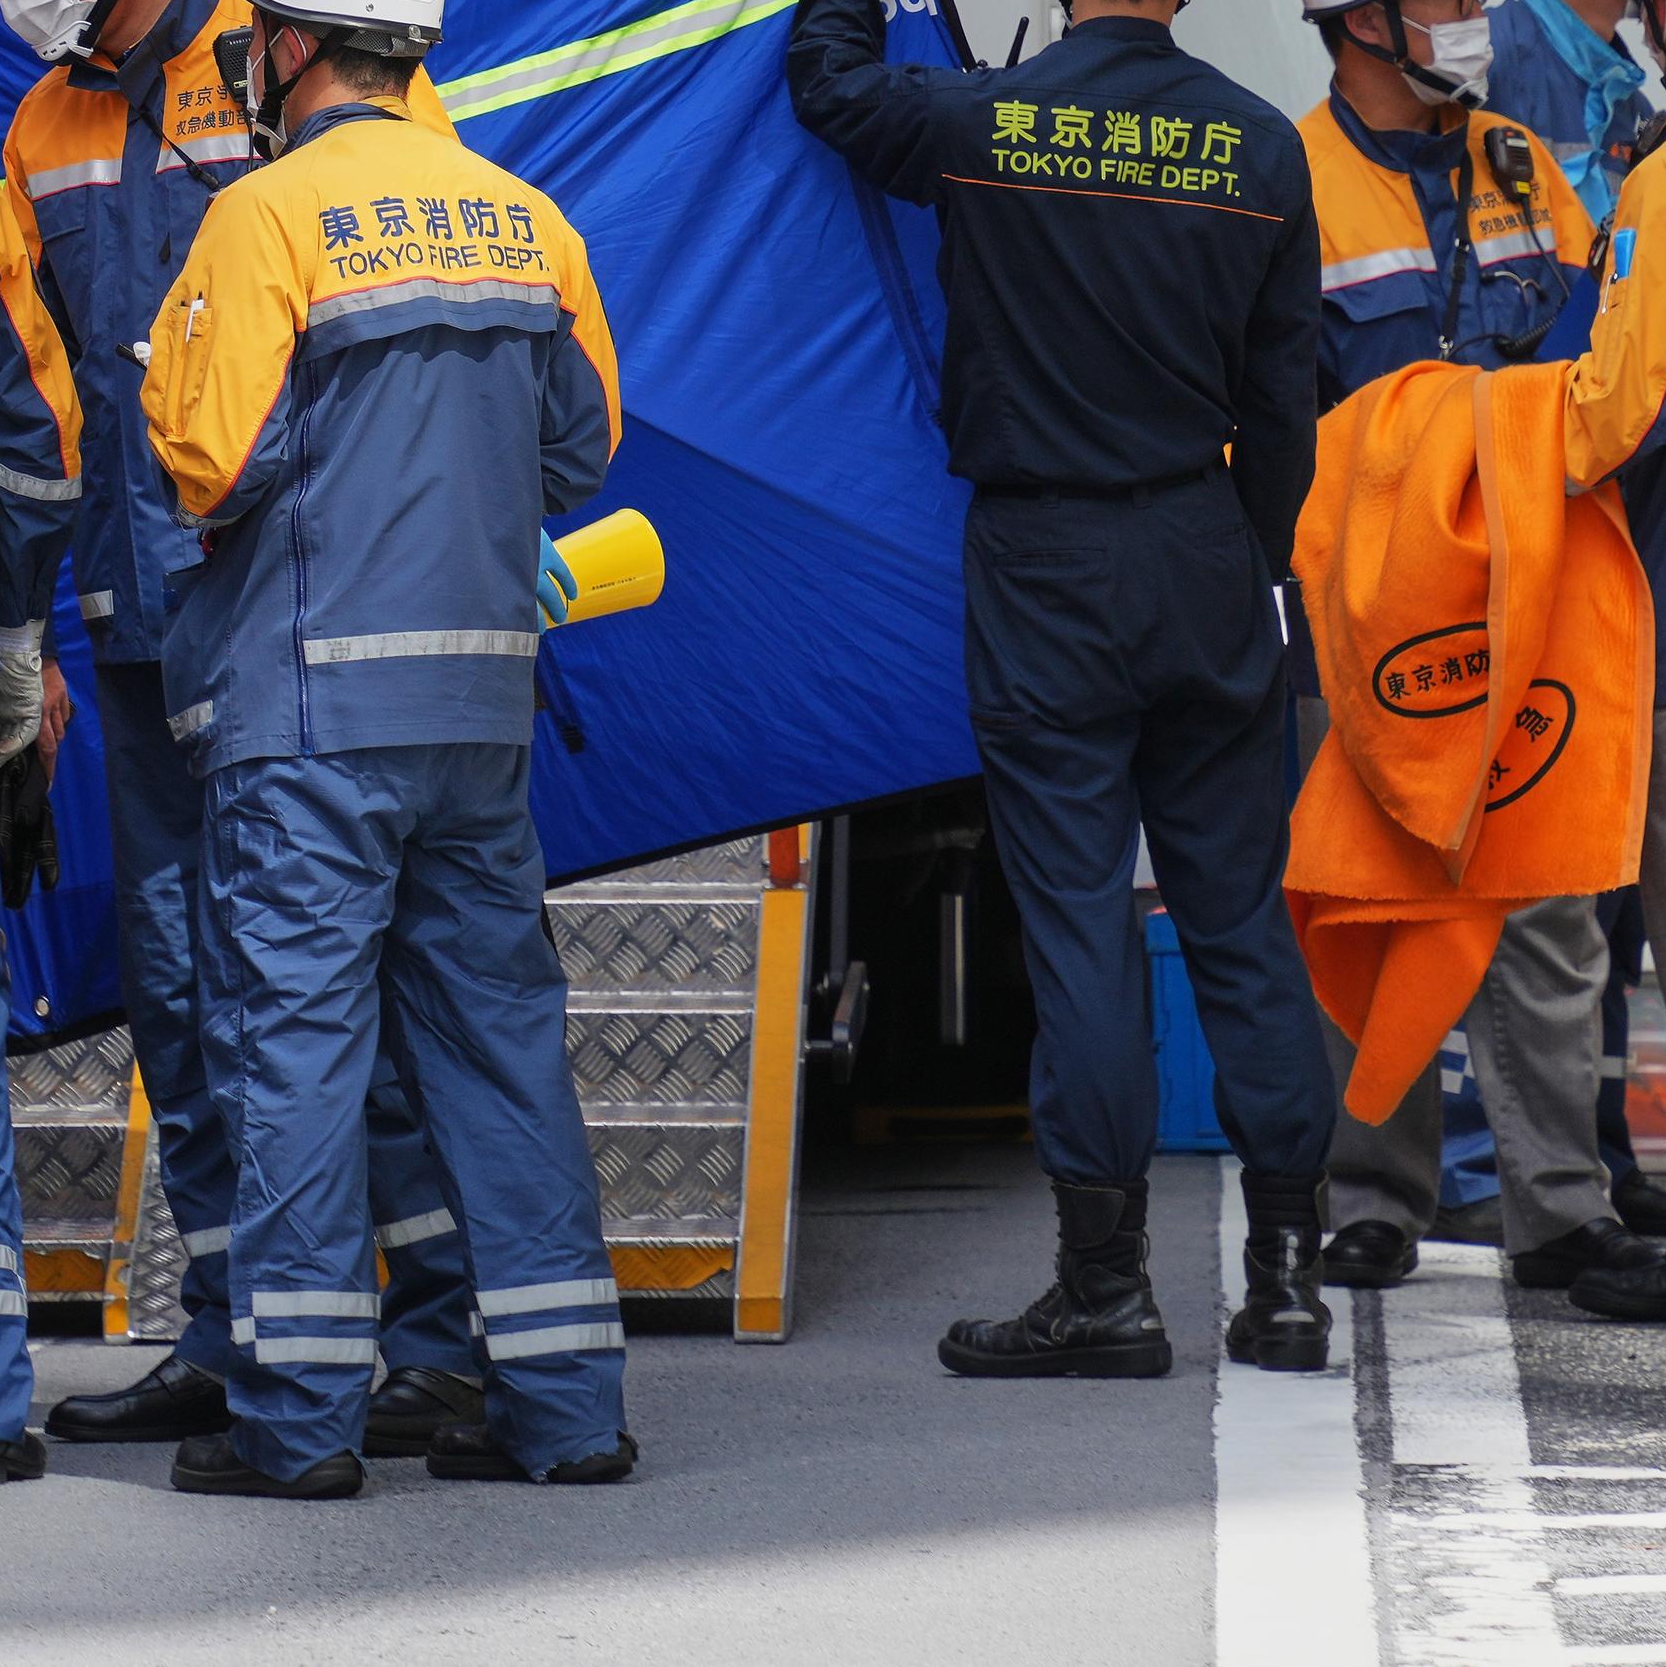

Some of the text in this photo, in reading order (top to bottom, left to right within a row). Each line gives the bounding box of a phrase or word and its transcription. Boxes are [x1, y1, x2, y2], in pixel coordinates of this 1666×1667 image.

[991, 99, 1242, 165] 東京消防庁
[991, 149, 1241, 197] TOKYO FIRE DEPT.
[319, 196, 535, 251] 東京消防庁
[330, 242, 550, 279] TOKYO FIRE DEPT.
